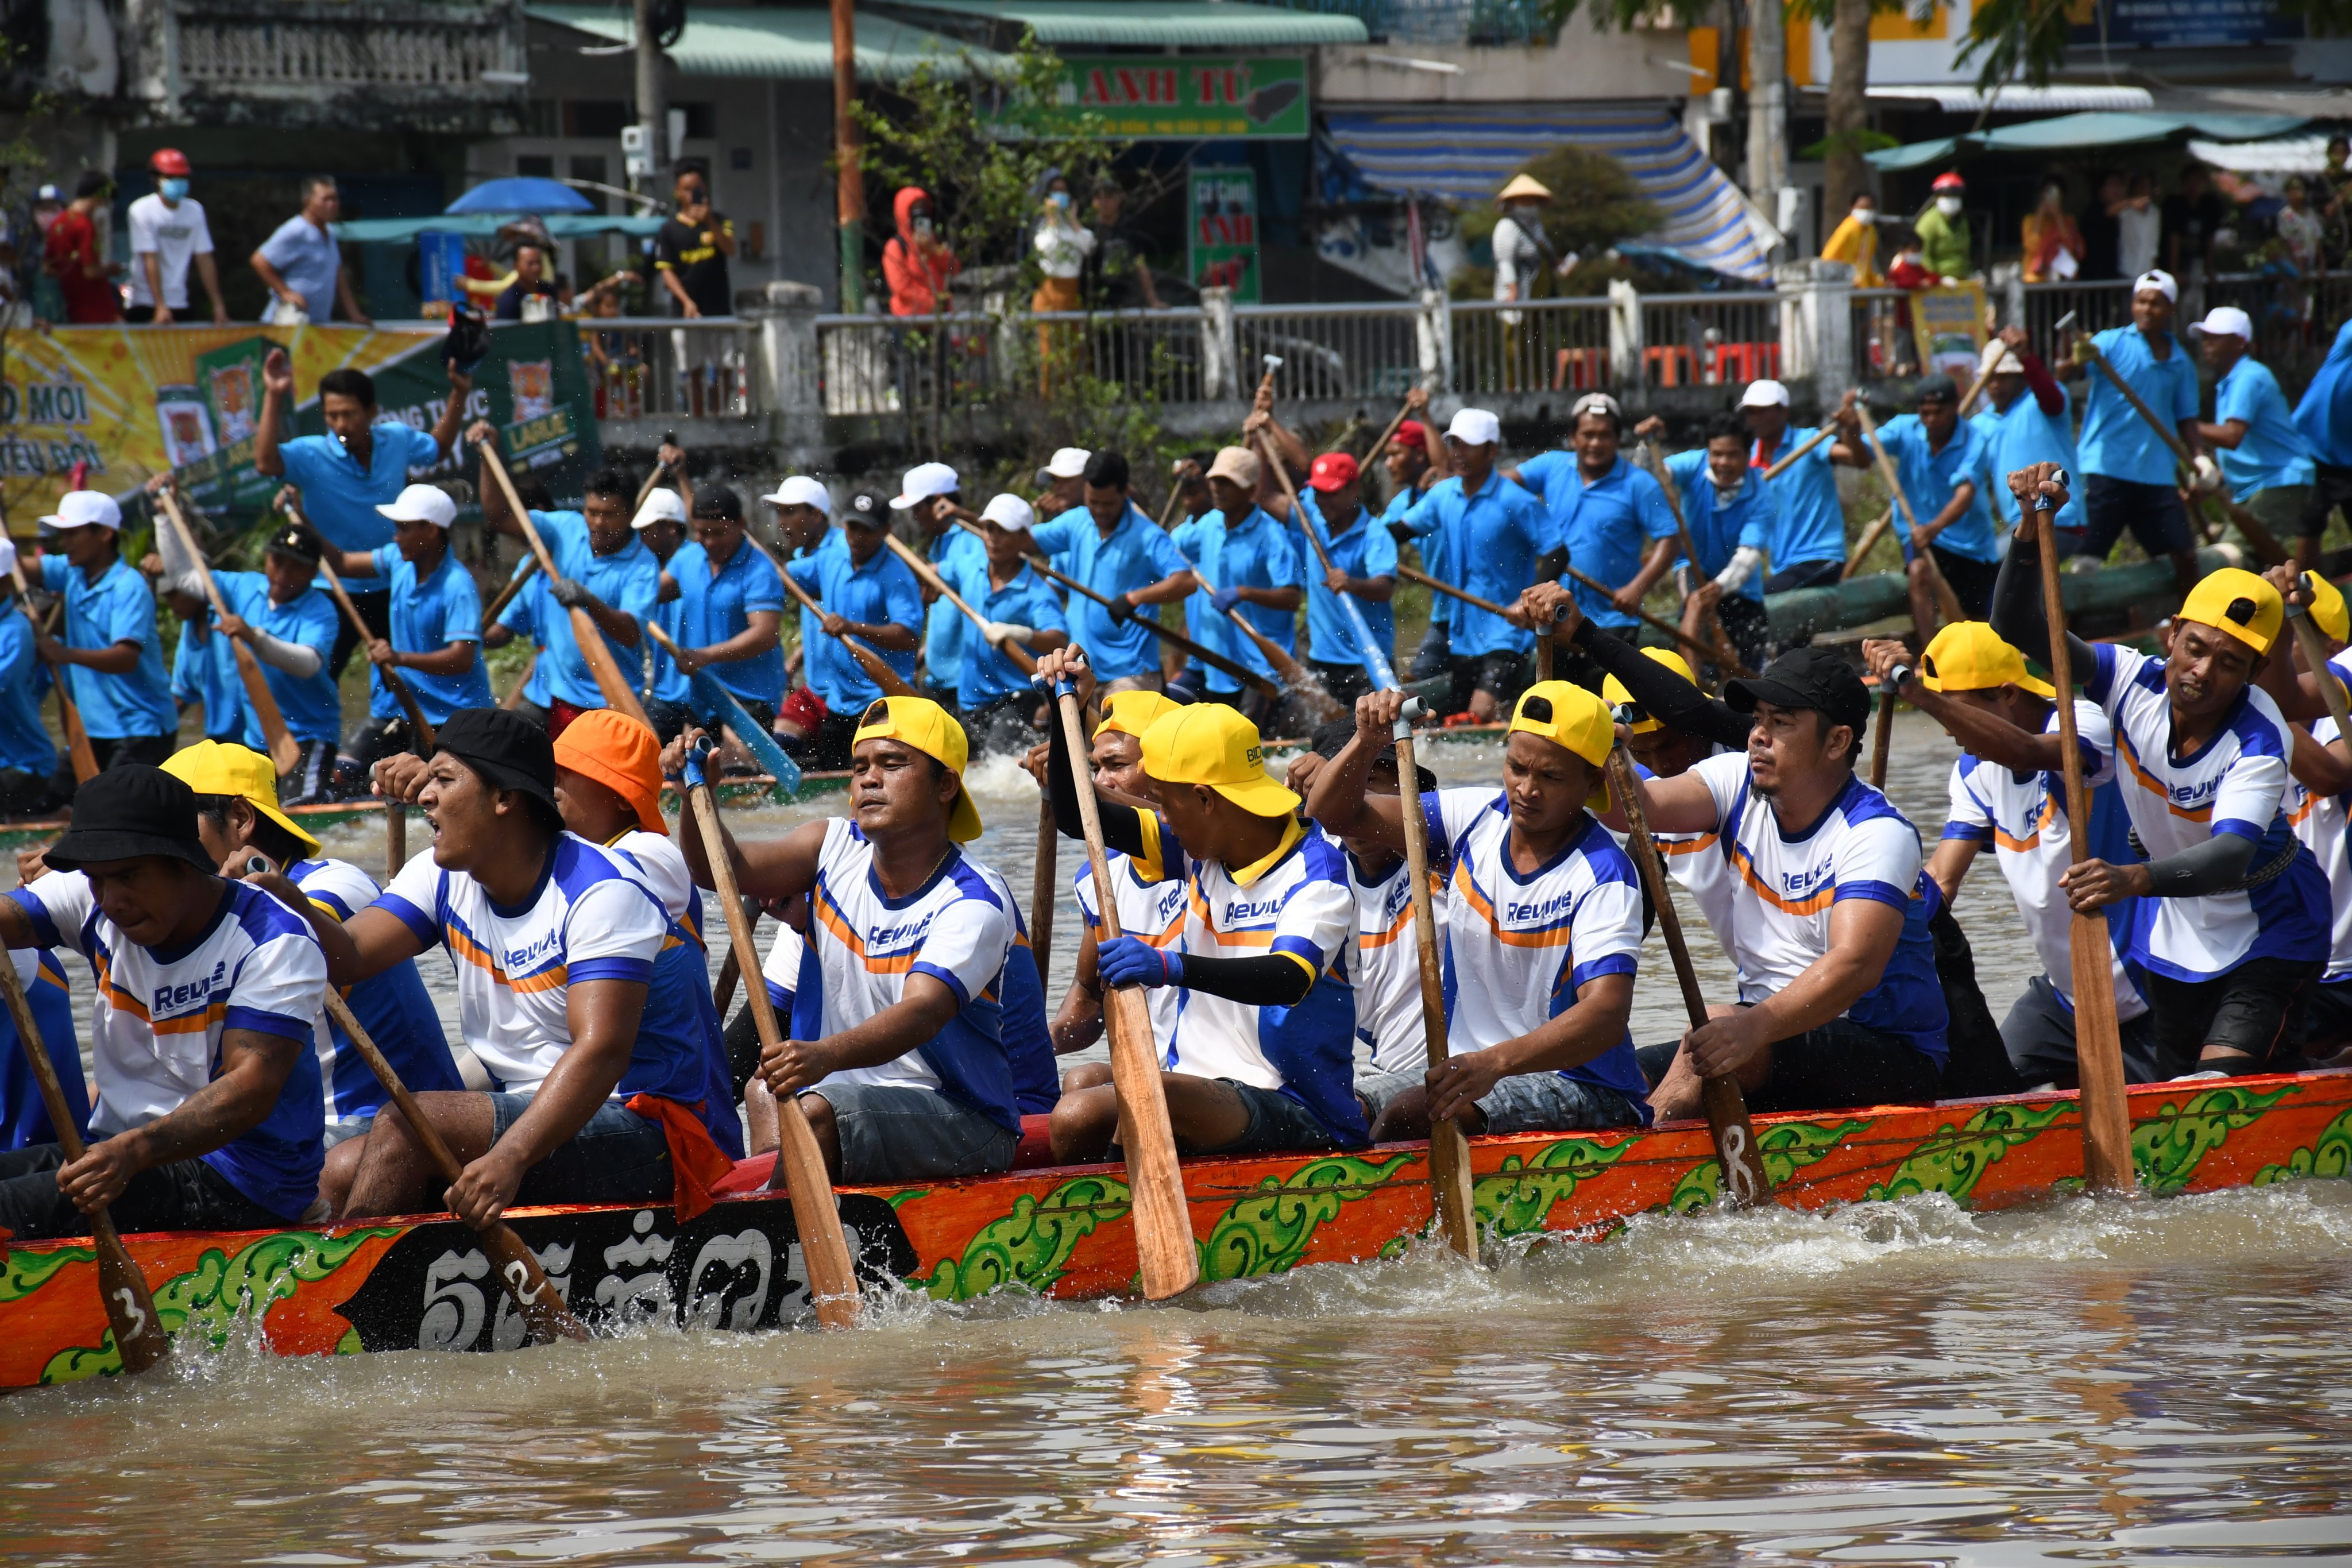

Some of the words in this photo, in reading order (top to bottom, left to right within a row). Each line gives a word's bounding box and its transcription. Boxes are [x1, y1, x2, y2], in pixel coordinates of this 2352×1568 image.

[1082, 68, 1178, 106] ANH
[508, 410, 569, 453] LARUE
[1507, 890, 1573, 924] Revive
[1723, 1125, 1754, 1203] 8
[504, 1260, 547, 1305] 2
[113, 1287, 146, 1342] 3
